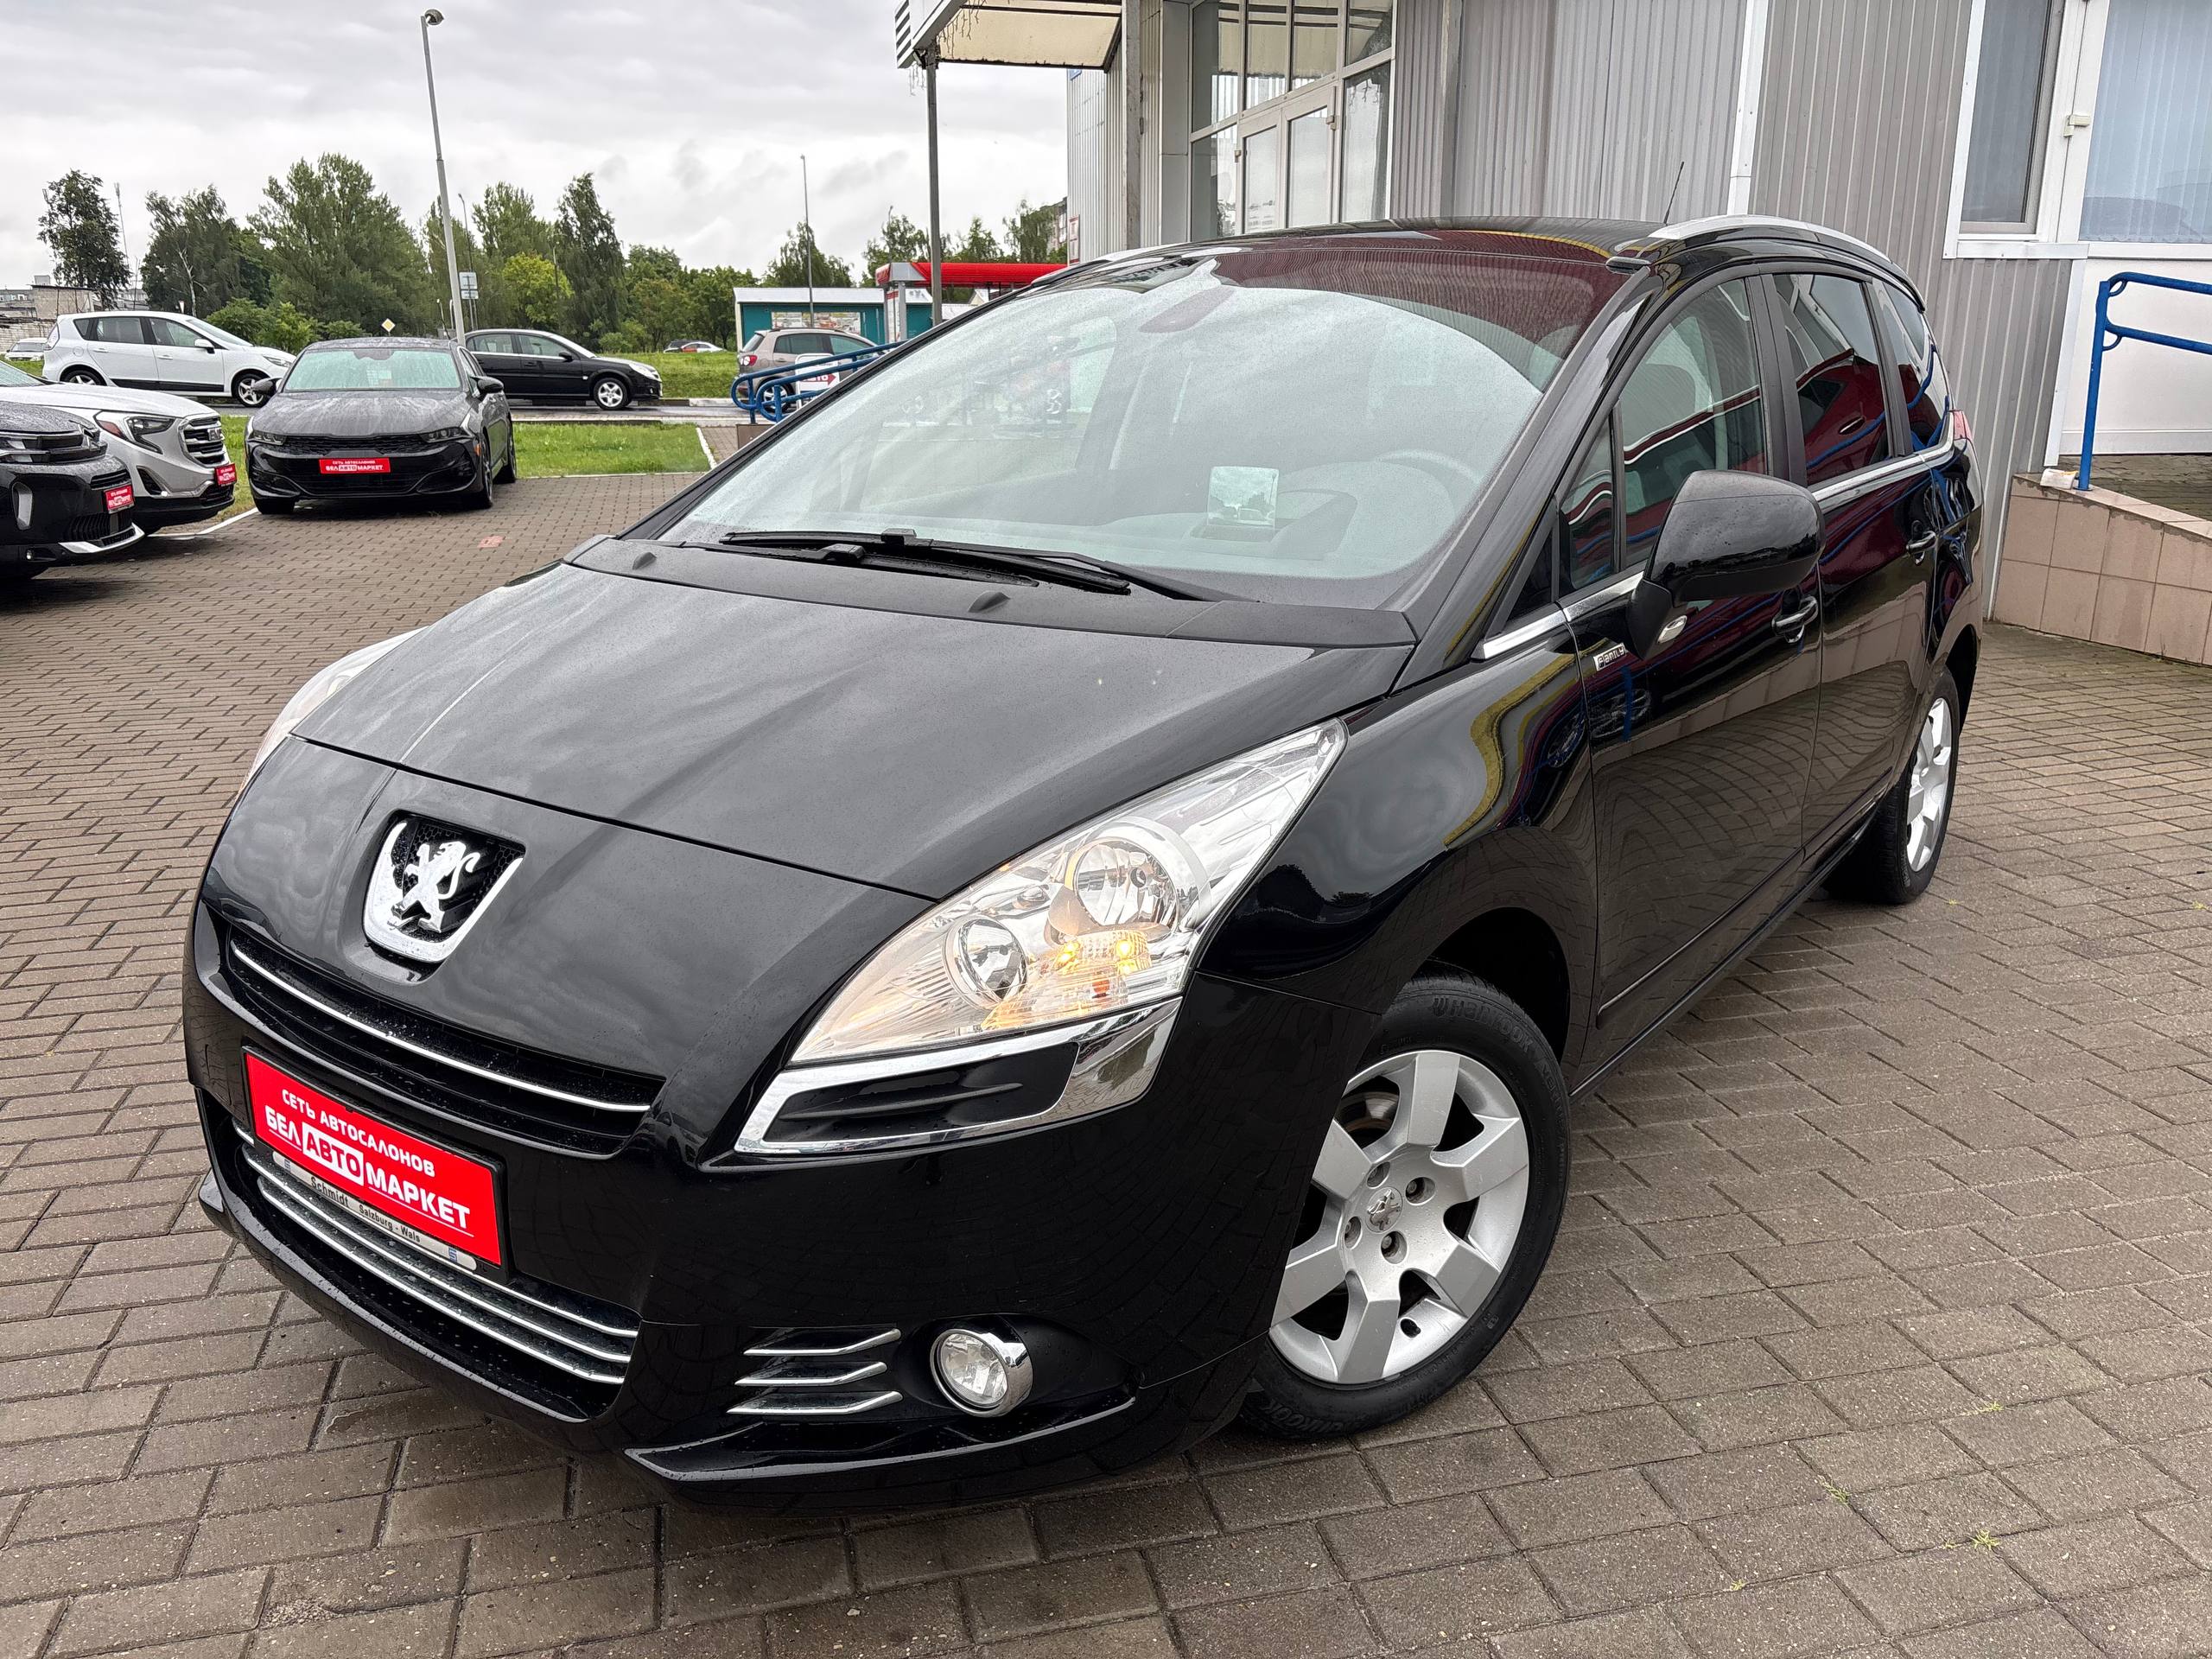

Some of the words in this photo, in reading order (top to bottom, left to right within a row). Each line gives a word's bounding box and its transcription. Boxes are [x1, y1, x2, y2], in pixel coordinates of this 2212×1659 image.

[281, 1089, 316, 1121] СЕТЬ
[319, 1110, 435, 1178] АВТОСАЛОНОВ
[310, 1176, 350, 1208] Schmidt
[359, 1204, 394, 1231] Salzburg
[400, 1224, 422, 1243] Wals
